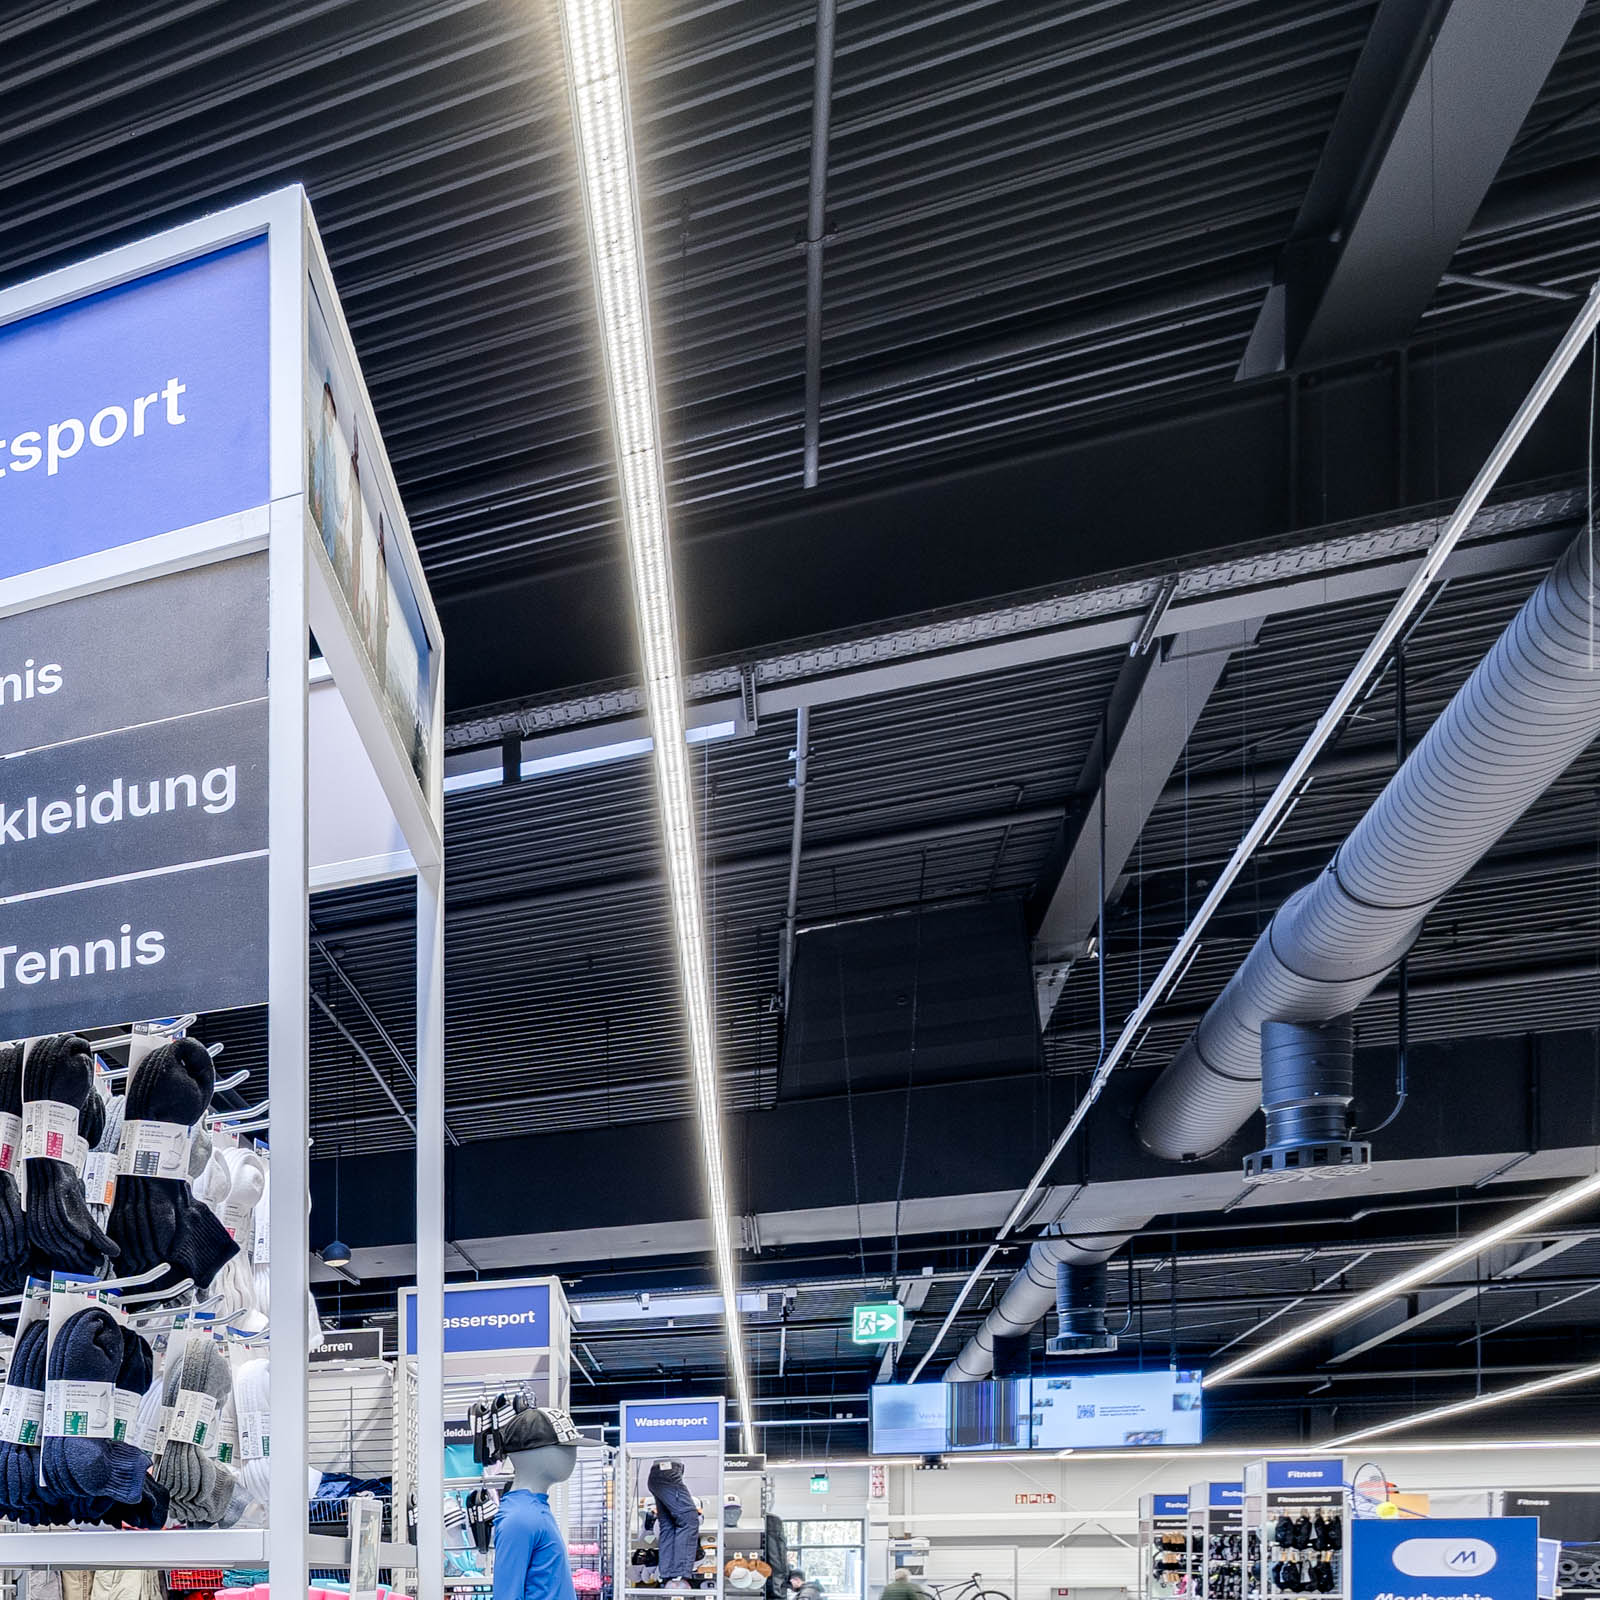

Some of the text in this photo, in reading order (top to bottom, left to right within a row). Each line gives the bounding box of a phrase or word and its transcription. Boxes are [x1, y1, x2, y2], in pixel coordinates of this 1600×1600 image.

[442, 1310, 535, 1330] assersport
[634, 1415, 708, 1429] Wassersport
[1287, 1470, 1323, 1479] Fitness
[1516, 1498, 1550, 1506] Fitness
